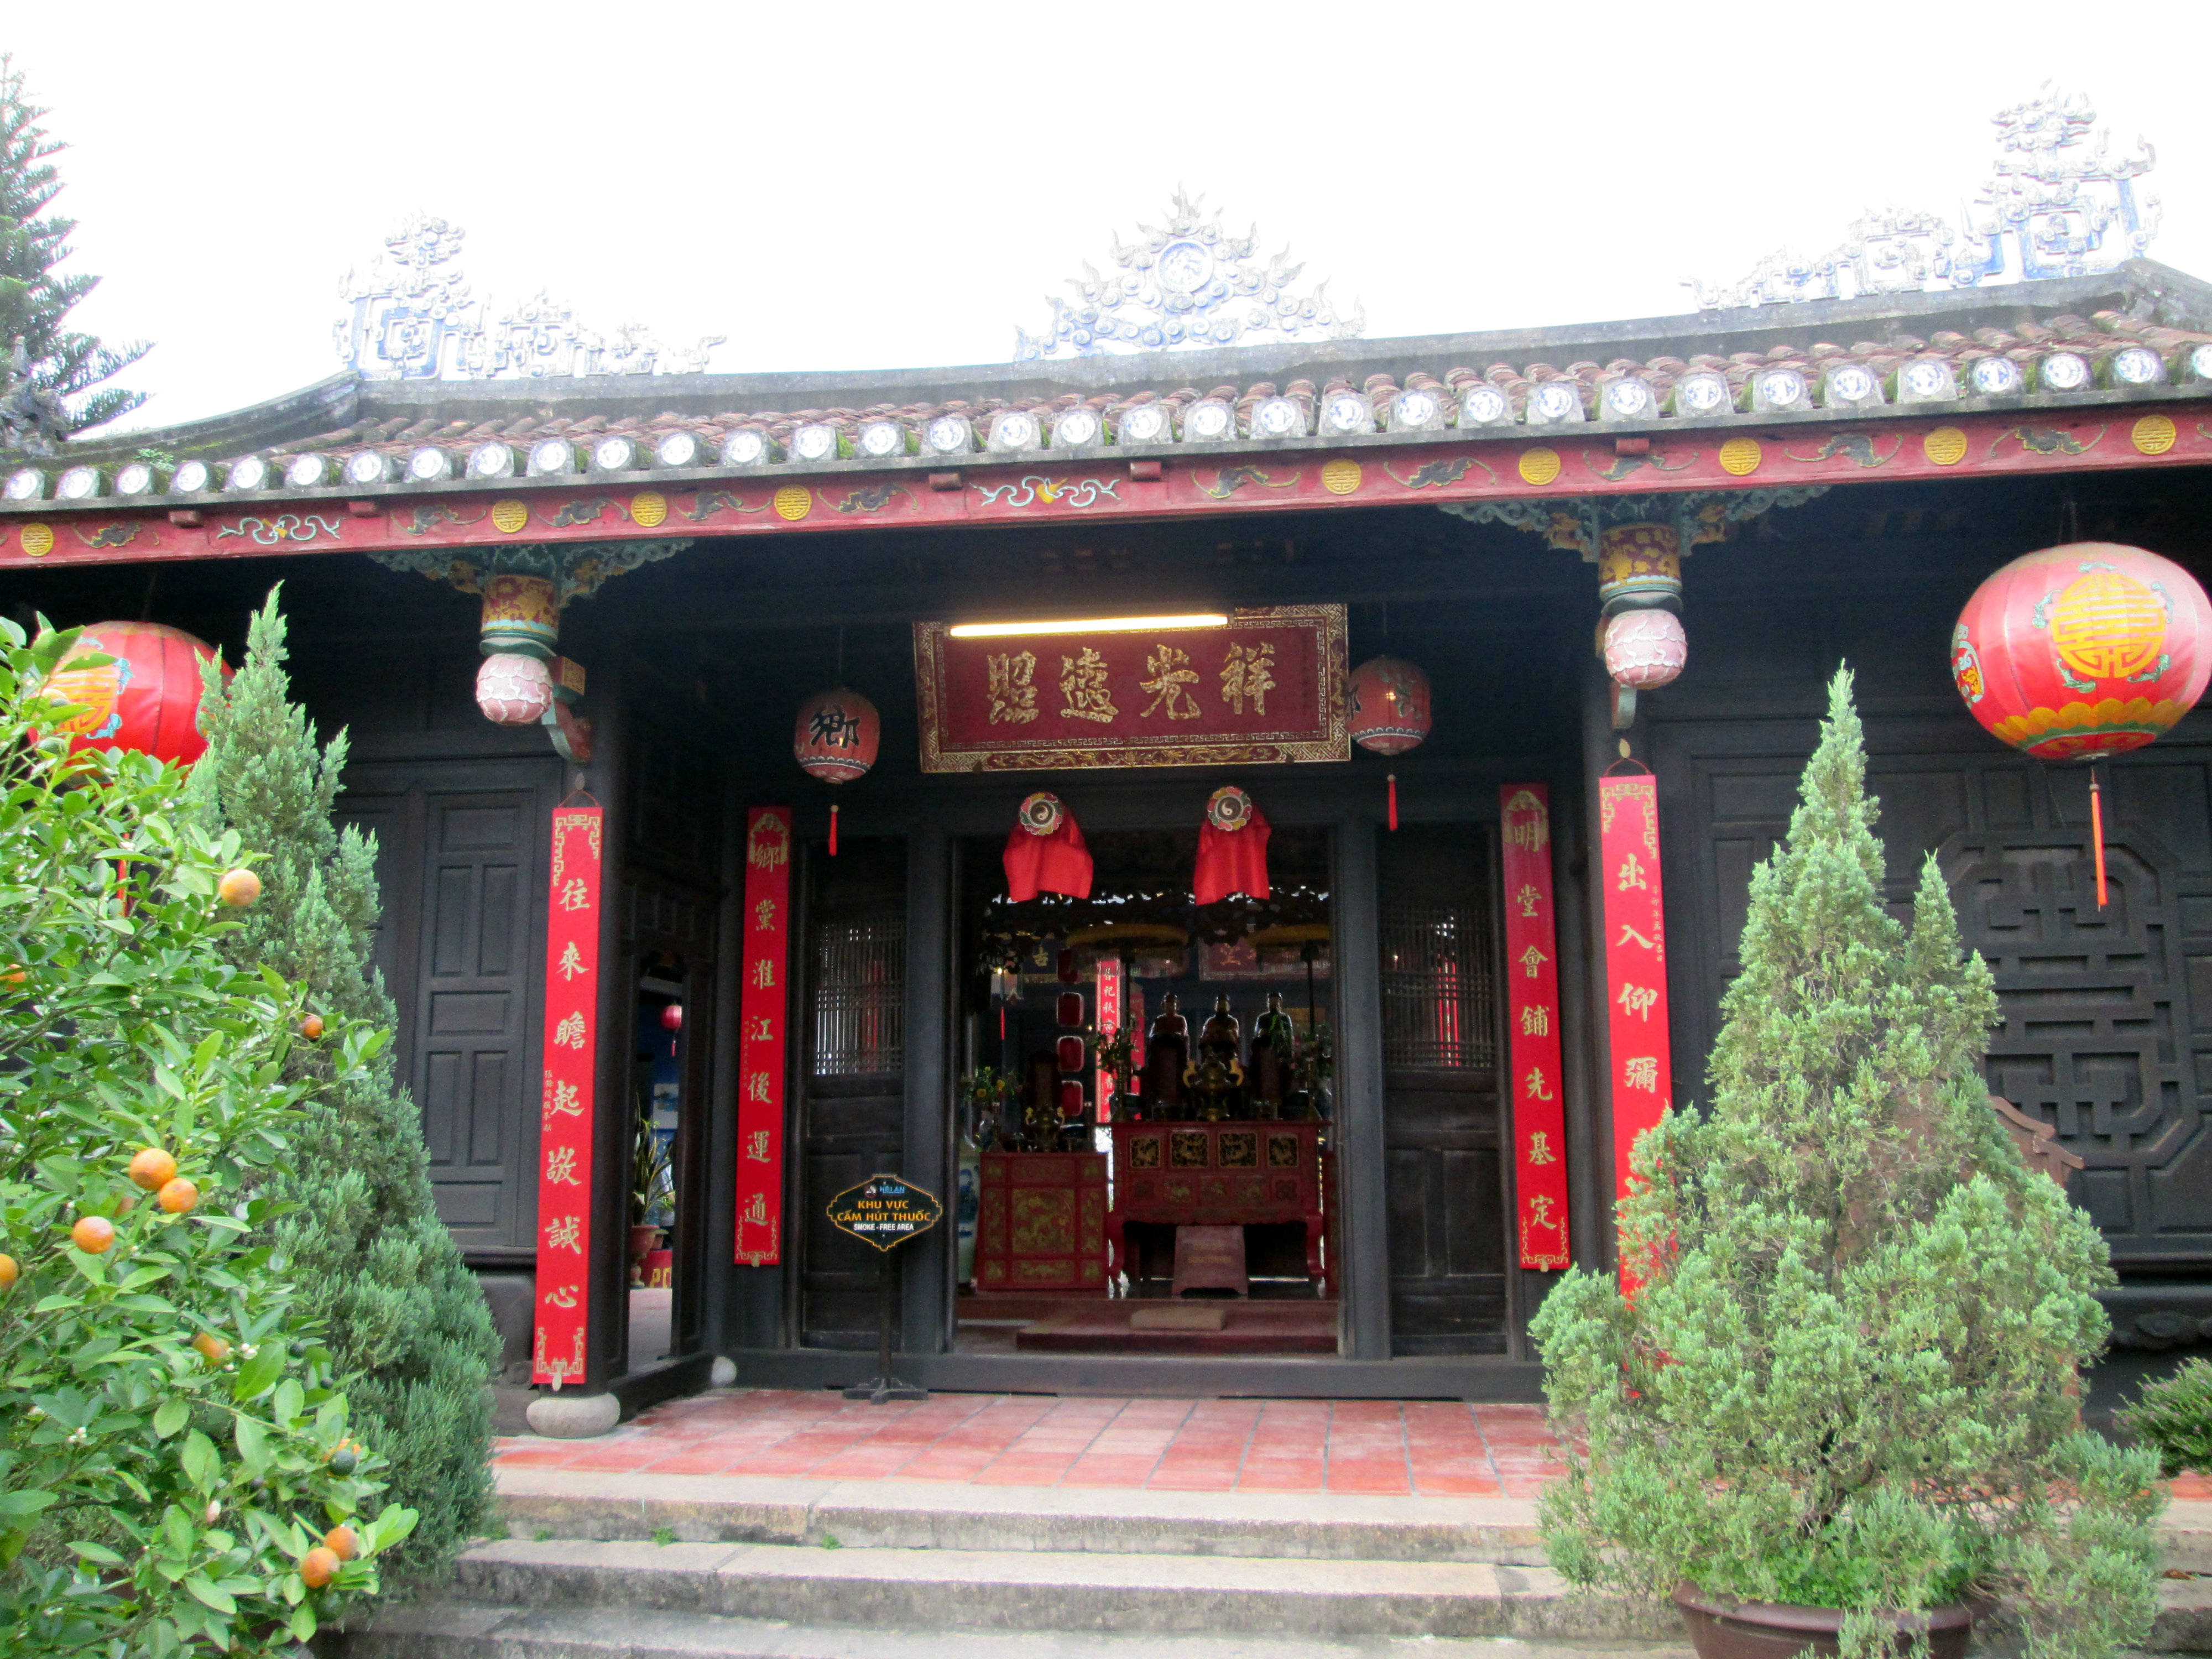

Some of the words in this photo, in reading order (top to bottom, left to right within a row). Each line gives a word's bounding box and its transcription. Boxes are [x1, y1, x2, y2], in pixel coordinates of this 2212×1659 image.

[545, 878, 590, 1308] 往來瞻起敬誠心
[858, 1200, 882, 1209] KHU
[885, 1199, 909, 1211] VỰC
[837, 1209, 862, 1221] CẤM
[867, 1211, 889, 1221] HÚT
[892, 1209, 931, 1221] THUỐC
